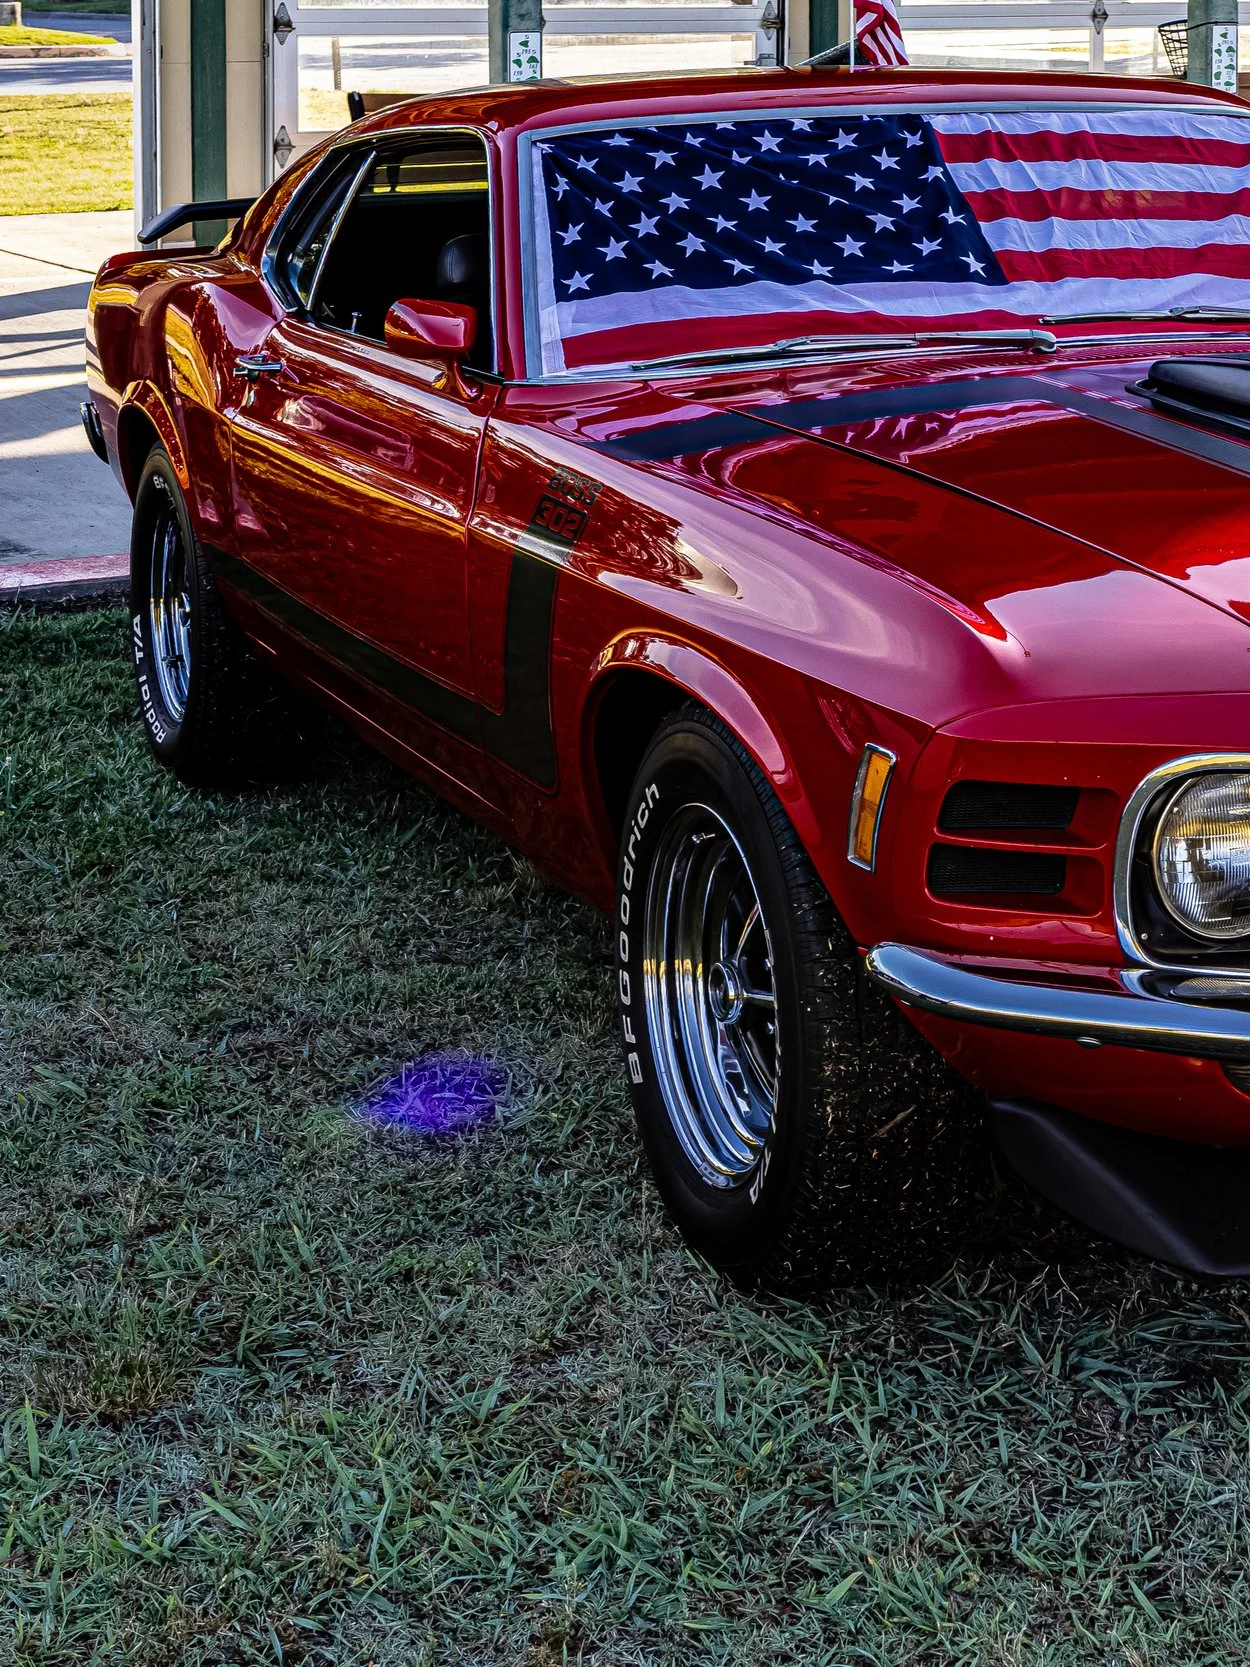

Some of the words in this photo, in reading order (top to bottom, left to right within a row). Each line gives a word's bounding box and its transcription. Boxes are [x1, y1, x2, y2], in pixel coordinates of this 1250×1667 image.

[548, 467, 603, 507] BOSS
[535, 501, 582, 540] 302
[133, 614, 144, 665] T/A
[139, 675, 167, 744] Radial
